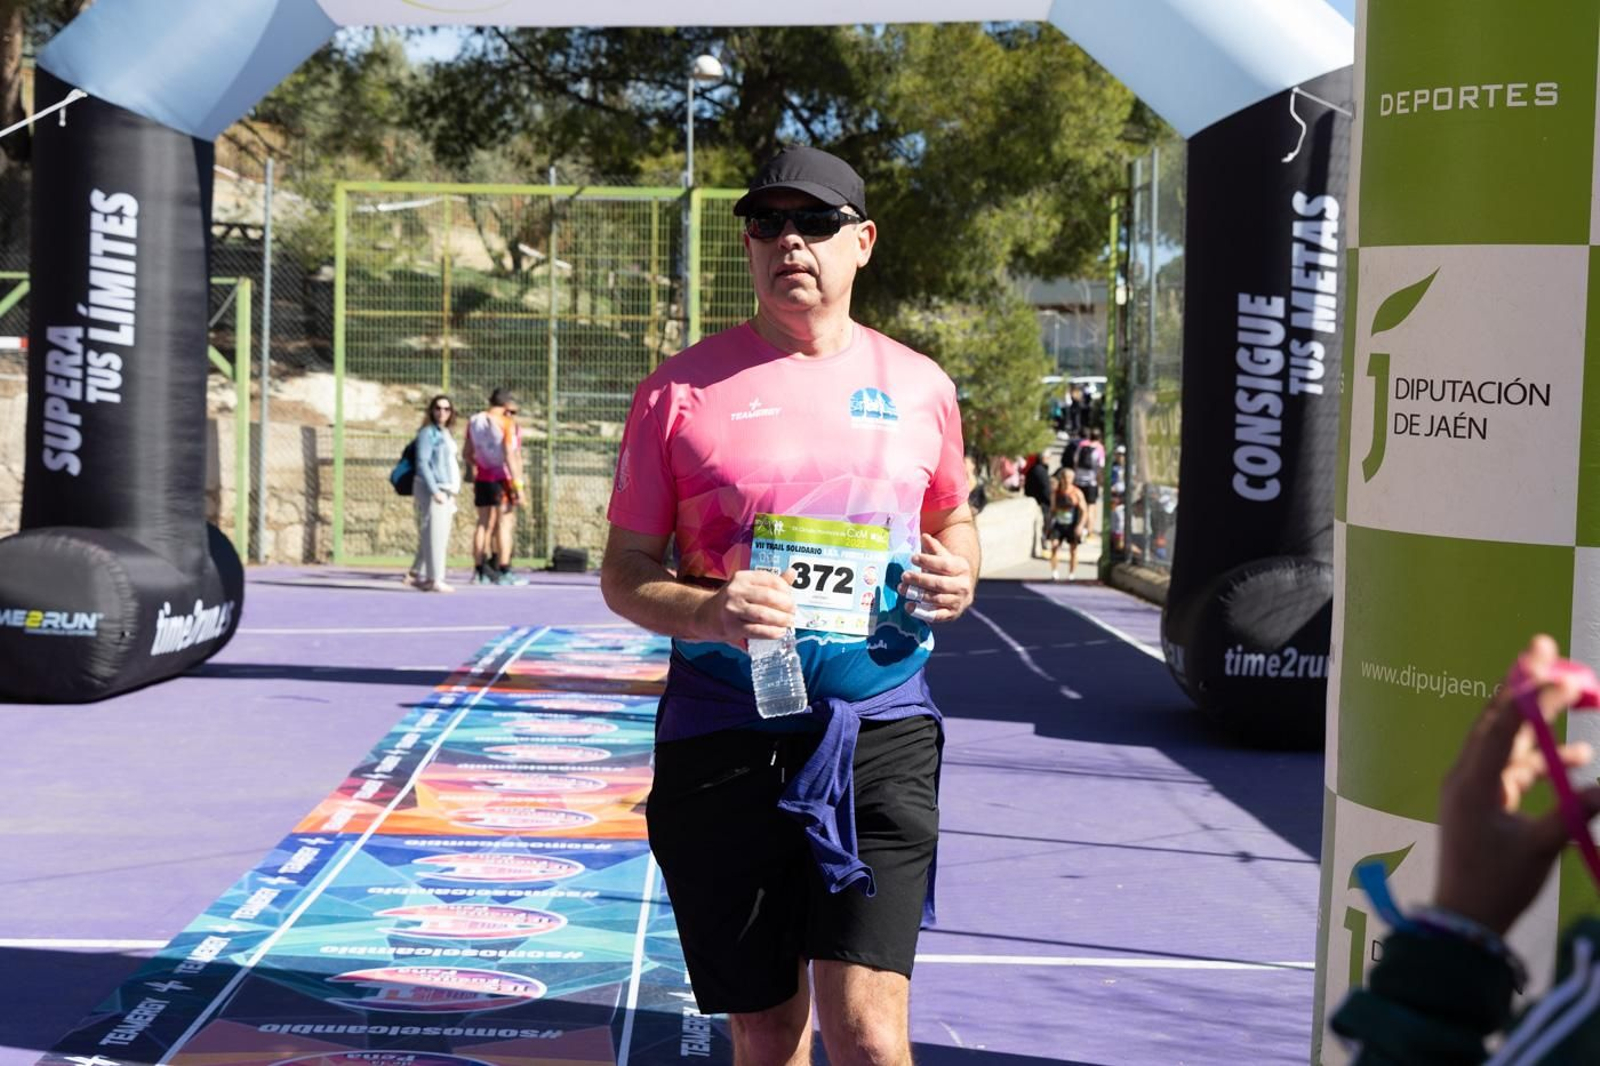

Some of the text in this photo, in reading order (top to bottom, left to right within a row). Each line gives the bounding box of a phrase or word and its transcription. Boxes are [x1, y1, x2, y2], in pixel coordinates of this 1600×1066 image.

[1380, 82, 1559, 116] DEPORTES
[77, 188, 139, 403] TUS LÍMITES
[1289, 190, 1340, 395] TUS METAS
[43, 326, 83, 477] SUPERA
[1232, 293, 1286, 502] CONSIGUE
[1395, 377, 1551, 407] DIPUTACIÓN
[1393, 411, 1488, 440] DE JAÉN
[766, 542, 785, 552] TRAIL
[786, 545, 823, 555] SOLIDARIO
[790, 562, 854, 595] 372
[258, 1023, 563, 1039] #somoselcambio
